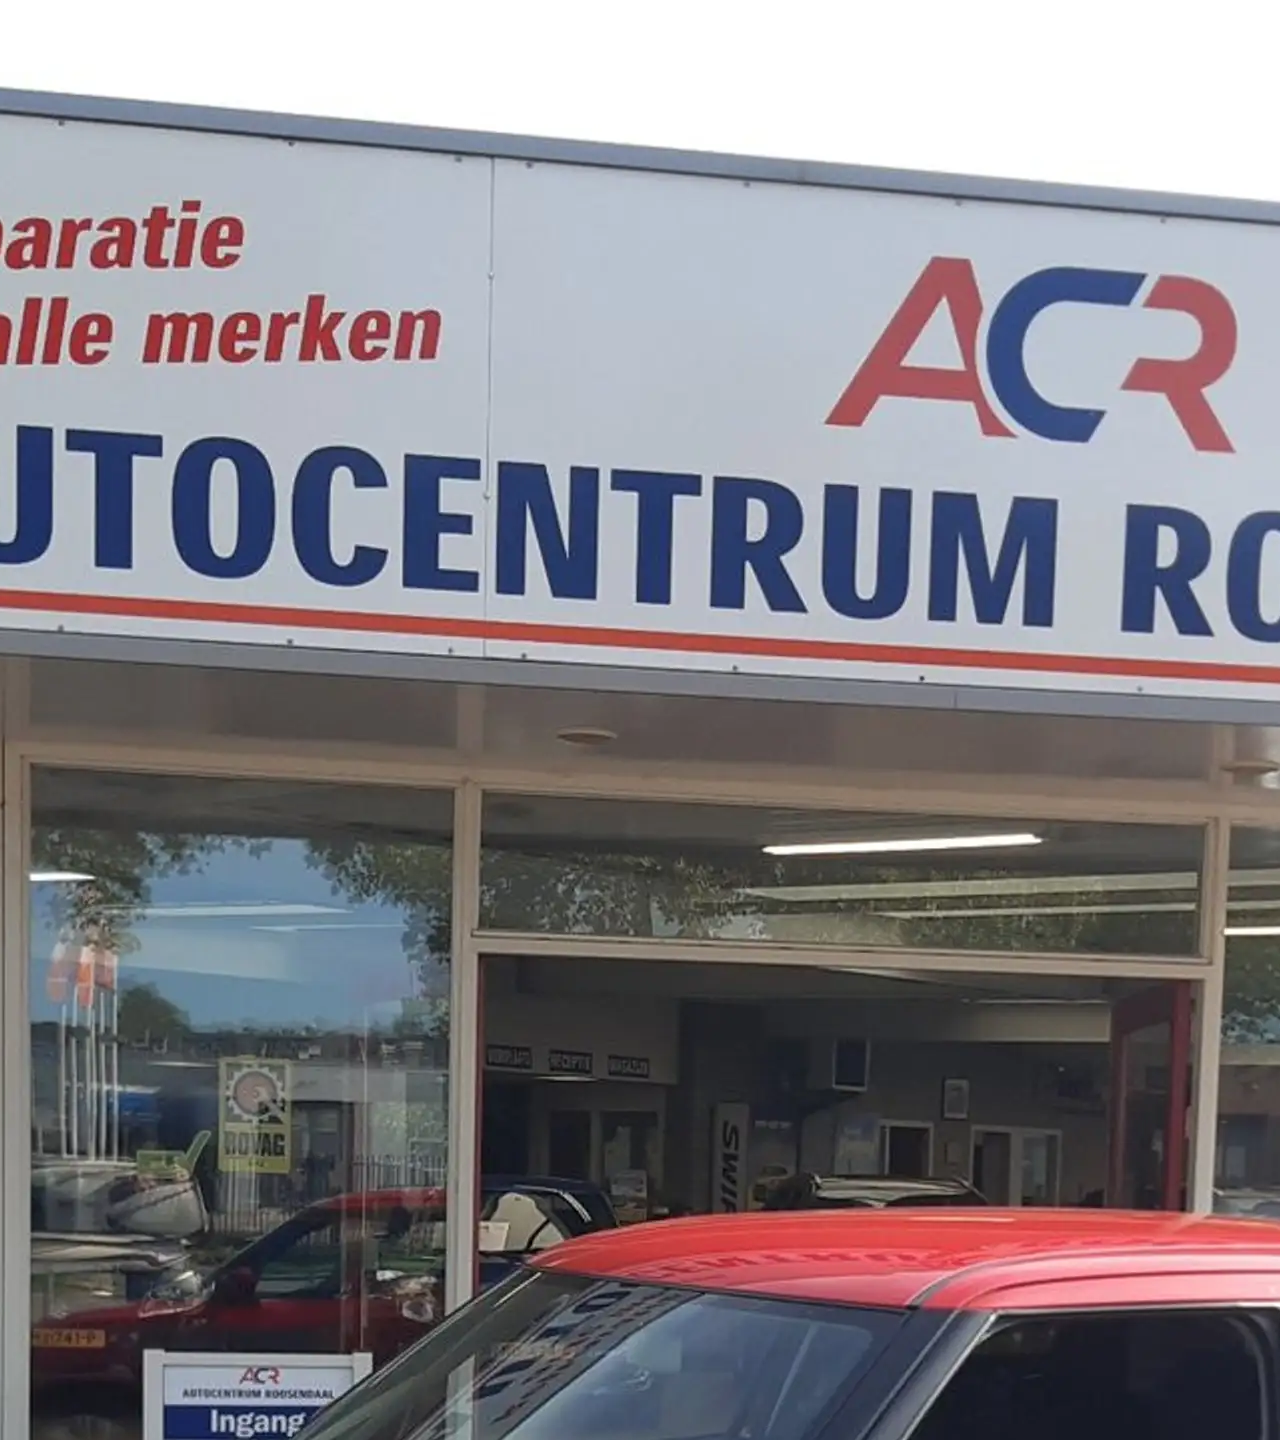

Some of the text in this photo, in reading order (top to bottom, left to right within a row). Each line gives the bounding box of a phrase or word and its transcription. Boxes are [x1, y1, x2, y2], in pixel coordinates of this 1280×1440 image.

[141, 293, 442, 364] merken
[825, 255, 1238, 454] ACR
[239, 1366, 281, 1384] ACR
[182, 1388, 262, 1399] AUTOCENTRUM
[210, 1408, 307, 1438] Ingang
